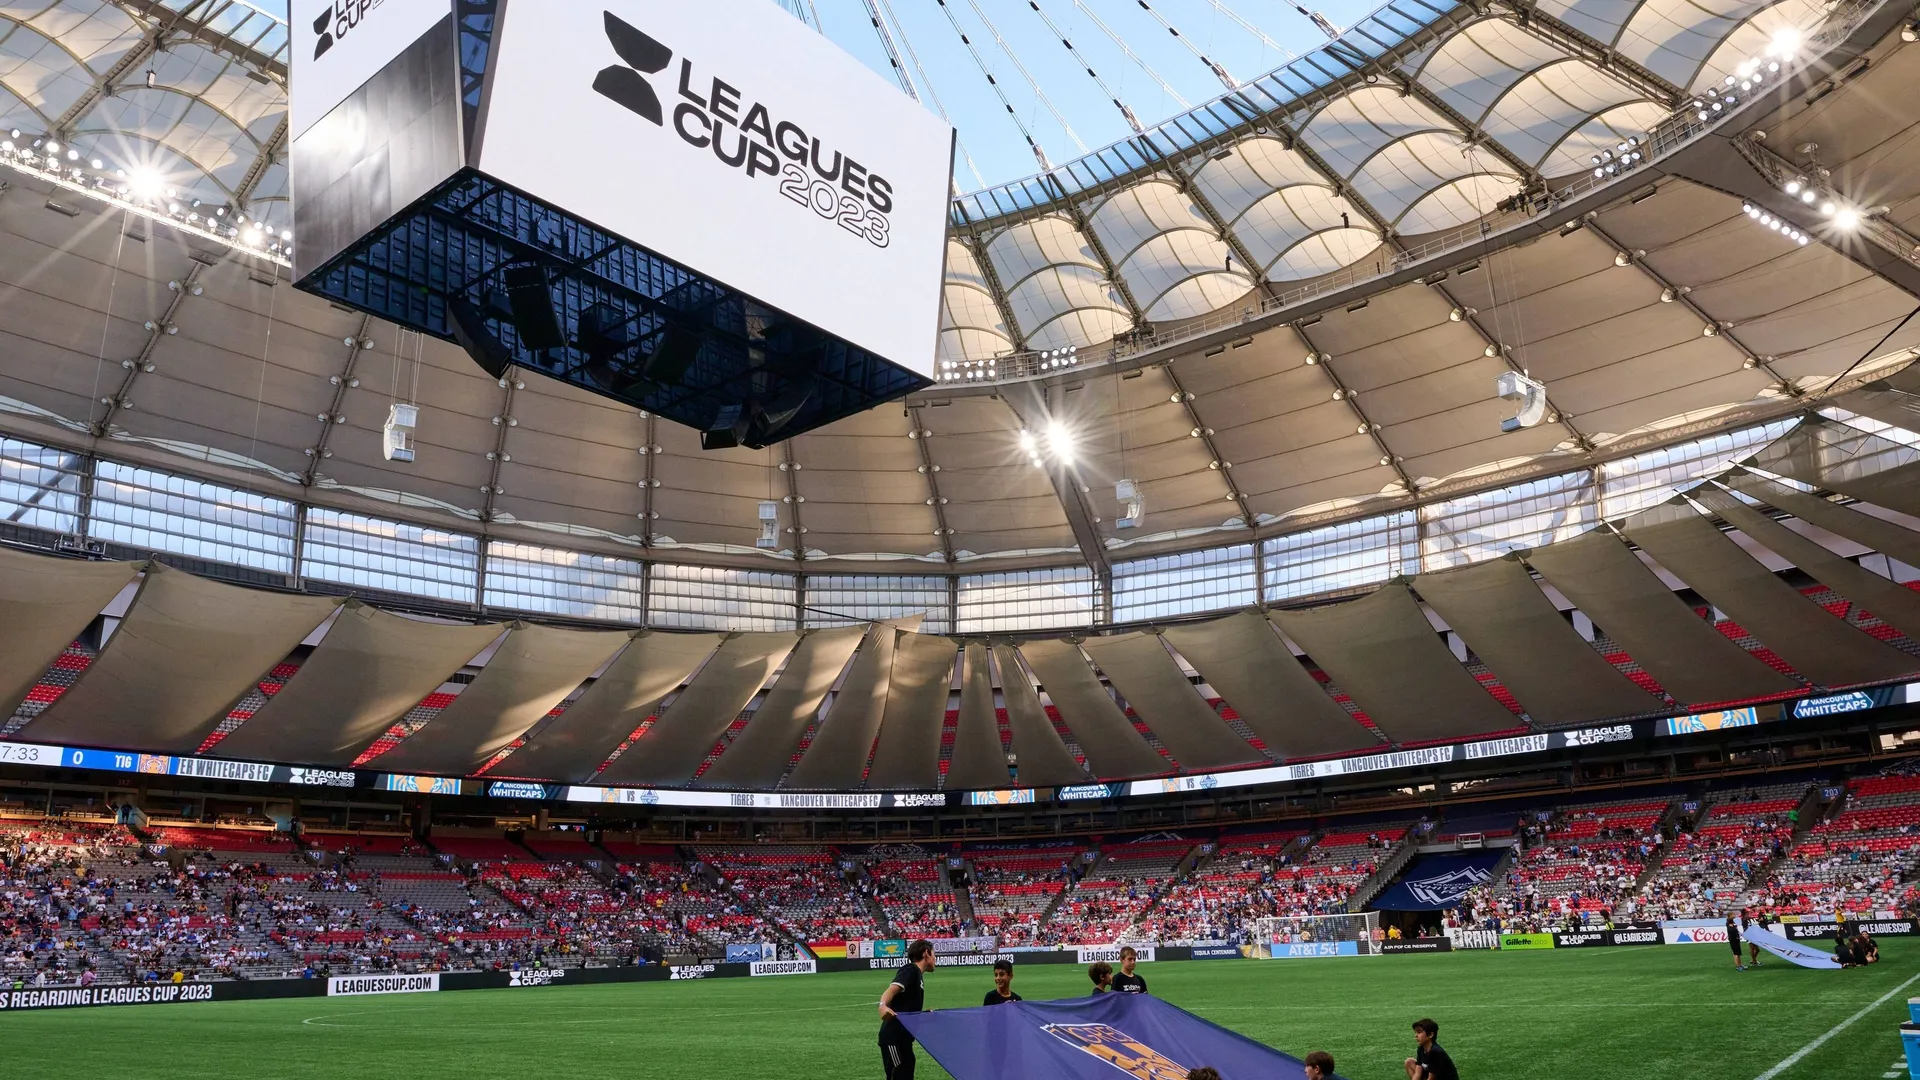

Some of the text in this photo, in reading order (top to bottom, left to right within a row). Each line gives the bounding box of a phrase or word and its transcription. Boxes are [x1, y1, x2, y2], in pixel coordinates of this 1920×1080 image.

[335, 0, 371, 39] CUP
[677, 57, 893, 214] LEAGUES
[673, 105, 891, 248] CUP 2023
[1810, 693, 1854, 705] VANCOUVER
[1799, 699, 1868, 717] WHITECAPS
[1579, 725, 1633, 738] LEAGUES
[1481, 738, 1532, 757] WHITECAPS
[1533, 736, 1546, 750] FC
[1580, 736, 1603, 745] CUP
[73, 751, 83, 765] 0
[115, 755, 132, 768] TIG
[1341, 756, 1389, 773] VANCOUVER
[1389, 749, 1438, 766] WHITECAPS
[1439, 747, 1451, 761] FC
[198, 759, 256, 779] WHITECAPS
[257, 765, 270, 780] FC
[305, 769, 356, 780] LEAGUES
[1289, 764, 1315, 779] TIGRES
[304, 776, 328, 785] CUP
[502, 782, 534, 790] VANCOUVER
[1186, 778, 1195, 789] VS
[493, 788, 542, 799] WHITECAPS
[626, 791, 635, 802] VS
[1062, 790, 1108, 800] WHITECAPS
[1825, 788, 1838, 797] 203
[730, 794, 755, 806] TIGRES
[780, 794, 824, 807] VANCOUVER
[826, 794, 868, 807] WHITECAPS
[868, 795, 878, 807] FC
[1684, 803, 1697, 811] 202
[1538, 813, 1549, 821] 201
[149, 845, 162, 854] 242
[1692, 927, 1729, 942] Coor
[1859, 923, 1911, 934] @LEAGUESCUP
[1463, 930, 1497, 948] RAIN
[1505, 938, 1532, 946] Gillette
[1614, 932, 1658, 944] @LEAGUESCUP
[934, 940, 994, 951] OUTHSIDERS
[1289, 943, 1339, 956] AT&T 5G
[870, 958, 879, 969] GET
[879, 958, 889, 968] THE
[889, 957, 908, 968] LATEST
[935, 955, 958, 965] ARDING
[959, 954, 984, 965] LEAGUES
[985, 954, 997, 964] CUP
[997, 953, 1014, 964] 2023
[1083, 950, 1149, 962] LEAGUESCOM
[522, 969, 565, 979] LEAGUES
[680, 964, 715, 973] LEAGUES
[754, 962, 812, 974] LEAGUESCUP.COM
[522, 977, 541, 986] CUP
[680, 971, 697, 980] CUP
[335, 977, 432, 993] LEAGUESCUP.COM
[10, 986, 92, 1008] REGARDING
[93, 986, 151, 1004] LEAGUES
[152, 985, 179, 1002] CUP
[180, 984, 213, 1000] 2023
